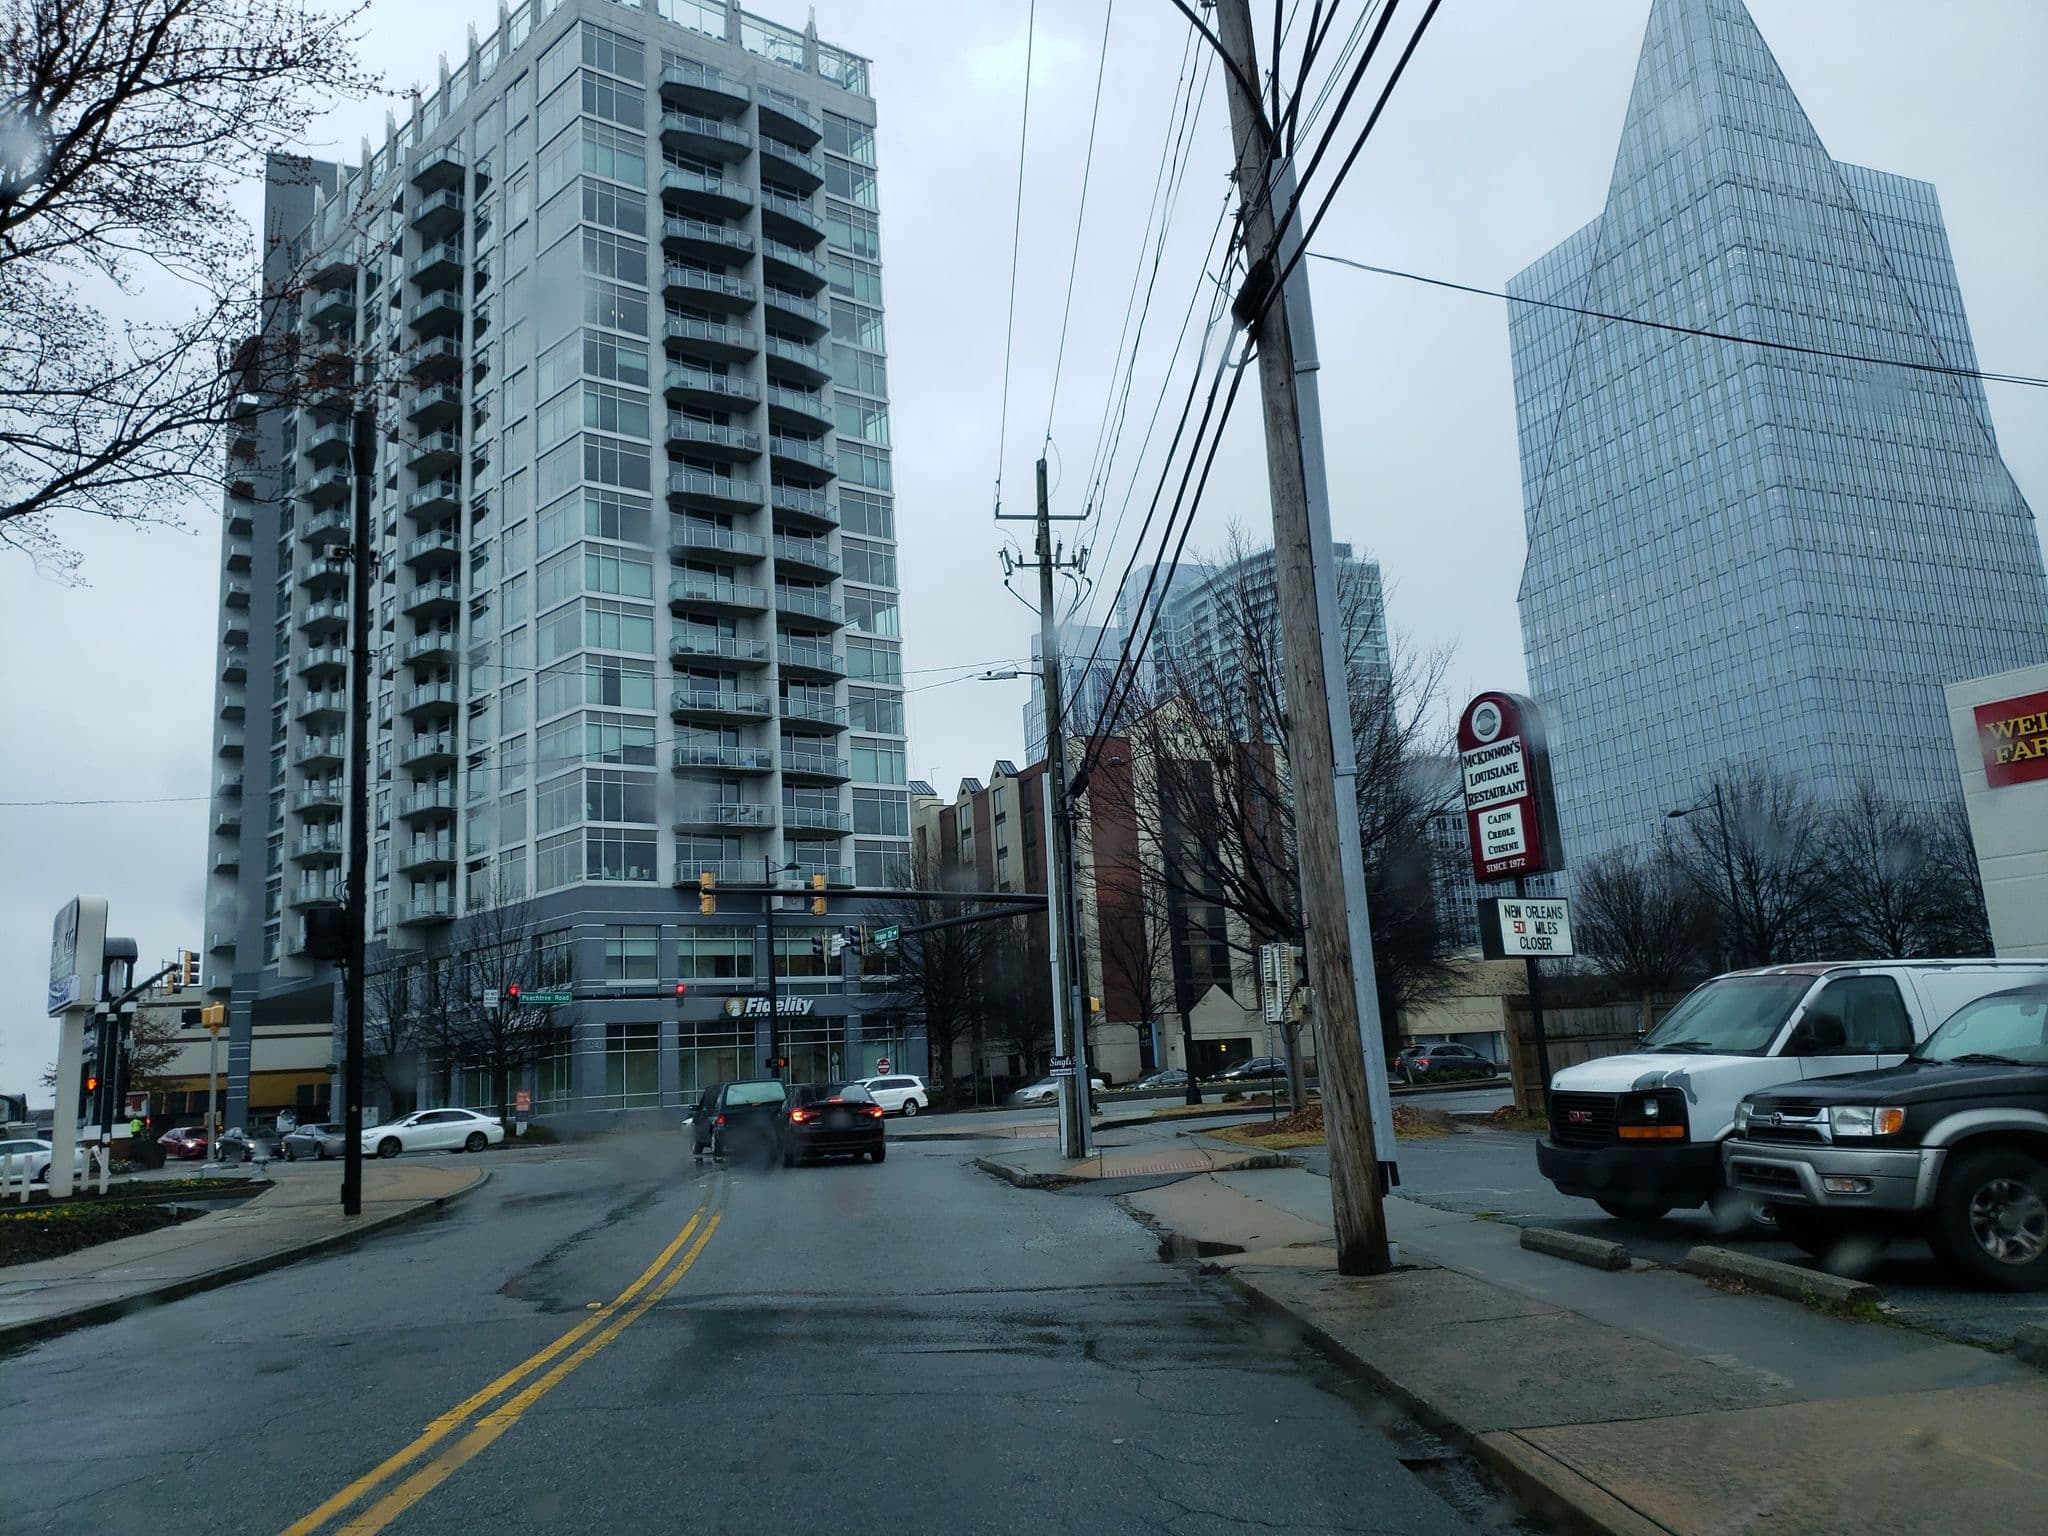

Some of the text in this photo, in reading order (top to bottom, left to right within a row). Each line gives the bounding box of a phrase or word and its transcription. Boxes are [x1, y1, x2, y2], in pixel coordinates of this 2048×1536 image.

[1469, 761, 1520, 787] LOUISIANE
[1467, 780, 1525, 806] RESTAURANT
[1487, 811, 1512, 825] CAJUN
[1487, 827, 1516, 840] CREOLE
[1488, 841, 1519, 855] CUISINE
[1486, 857, 1526, 873] SINCE 1972
[1503, 904, 1564, 920] NEW ORLEANS
[1534, 920, 1559, 935] MILES
[1519, 936, 1553, 951] CLOSER
[521, 994, 552, 1002] Peachtree
